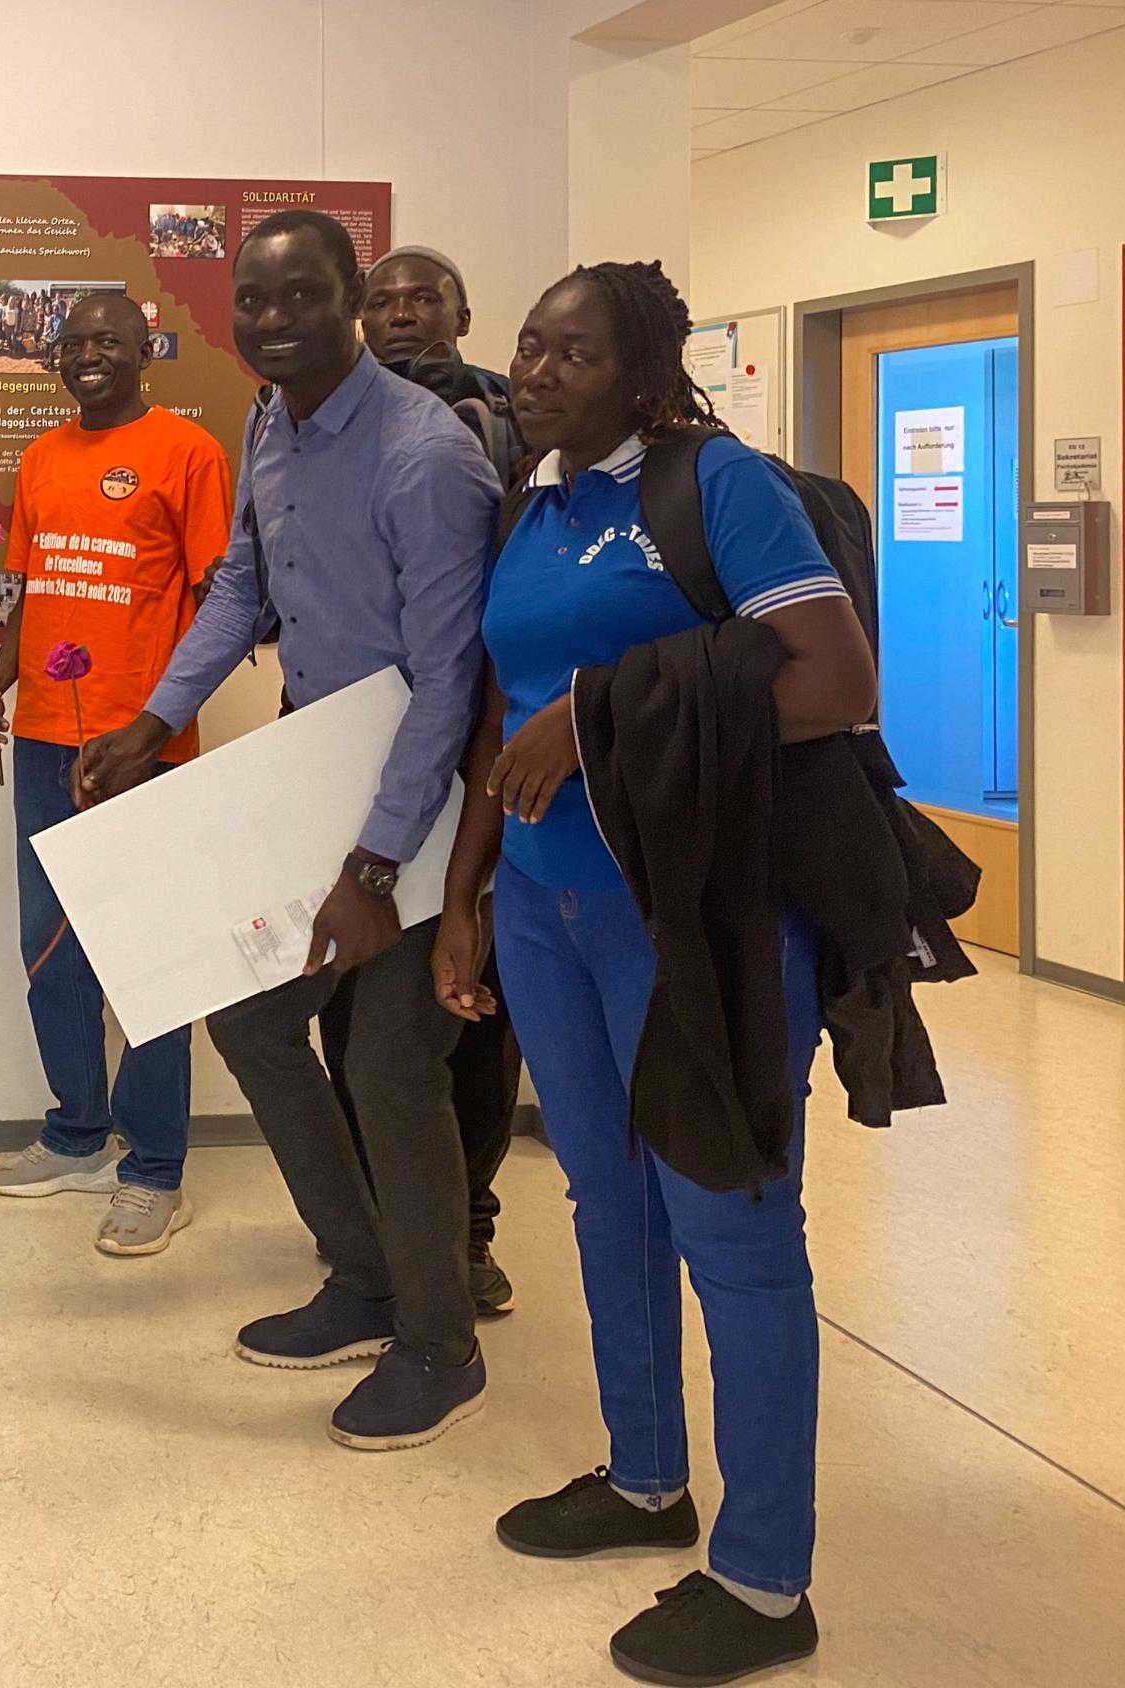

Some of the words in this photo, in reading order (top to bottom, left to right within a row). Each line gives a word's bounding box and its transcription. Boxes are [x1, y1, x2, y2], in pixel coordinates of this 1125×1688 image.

[242, 191, 316, 202] SOLIDARITÄT
[16, 216, 48, 225] kleinen
[51, 217, 81, 226] Orten,
[26, 227, 42, 236] das
[44, 227, 78, 236] Gesicht
[38, 247, 91, 257] Sprichwort)
[7, 406, 25, 415] der
[40, 532, 67, 550] Edition
[69, 534, 80, 550] de
[81, 534, 89, 551] la
[91, 538, 136, 559] caravane
[45, 554, 53, 571] de
[54, 555, 103, 576] l'excellence
[46, 578, 55, 595] du
[56, 578, 65, 596] 24
[65, 581, 75, 597] au
[76, 580, 87, 599] 29
[88, 583, 107, 600] août
[108, 584, 131, 605] 2023
